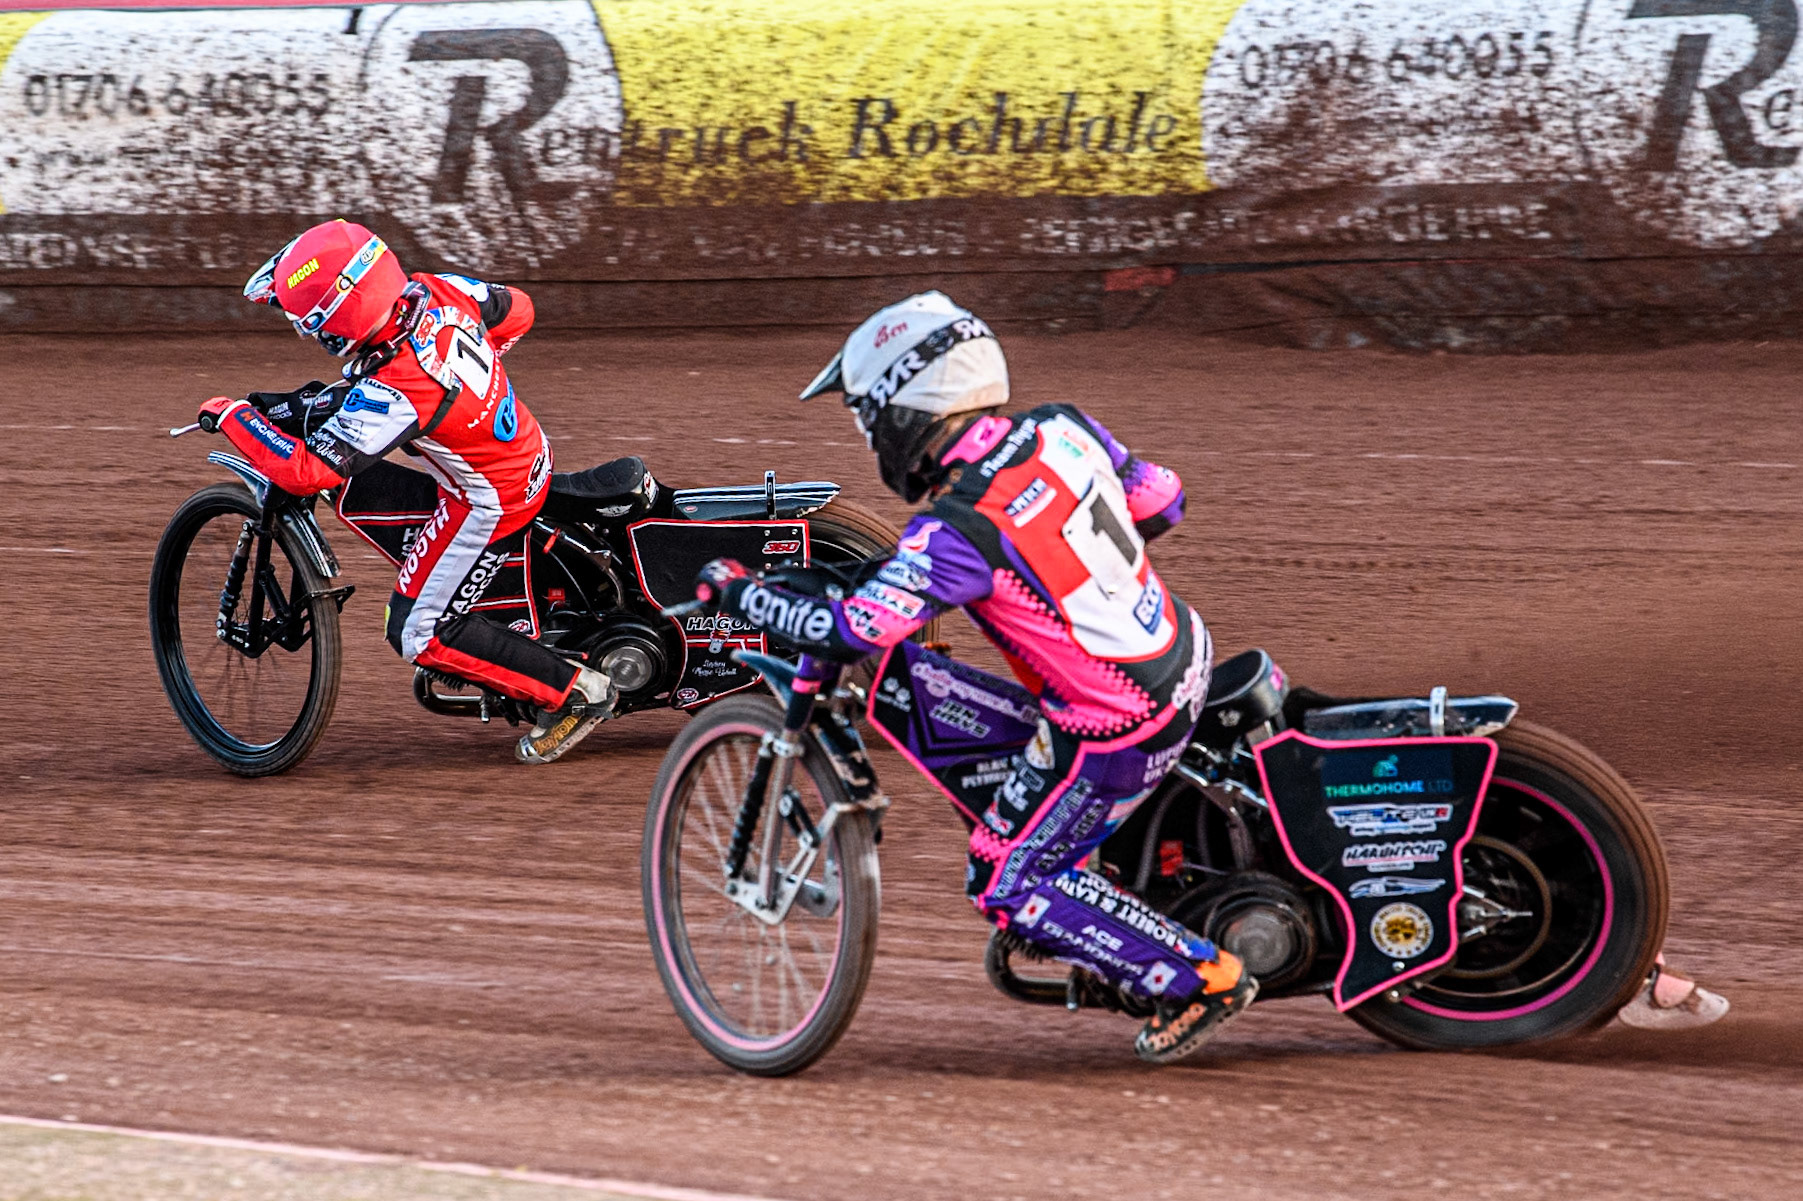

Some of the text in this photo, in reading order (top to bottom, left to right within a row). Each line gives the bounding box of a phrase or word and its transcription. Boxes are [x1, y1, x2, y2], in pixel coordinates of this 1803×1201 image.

[847, 91, 1178, 159] Rochdale
[287, 258, 320, 289] HAGON
[456, 338, 490, 374] 1
[400, 505, 450, 593] HAGON
[763, 540, 800, 554] 360
[1090, 492, 1138, 567] 1
[463, 551, 510, 614] HOCKS
[740, 582, 833, 641] Ignite
[1324, 780, 1424, 798] THERMOHOME
[1081, 924, 1124, 950] ACE
[1117, 904, 1178, 948] ROBERT
